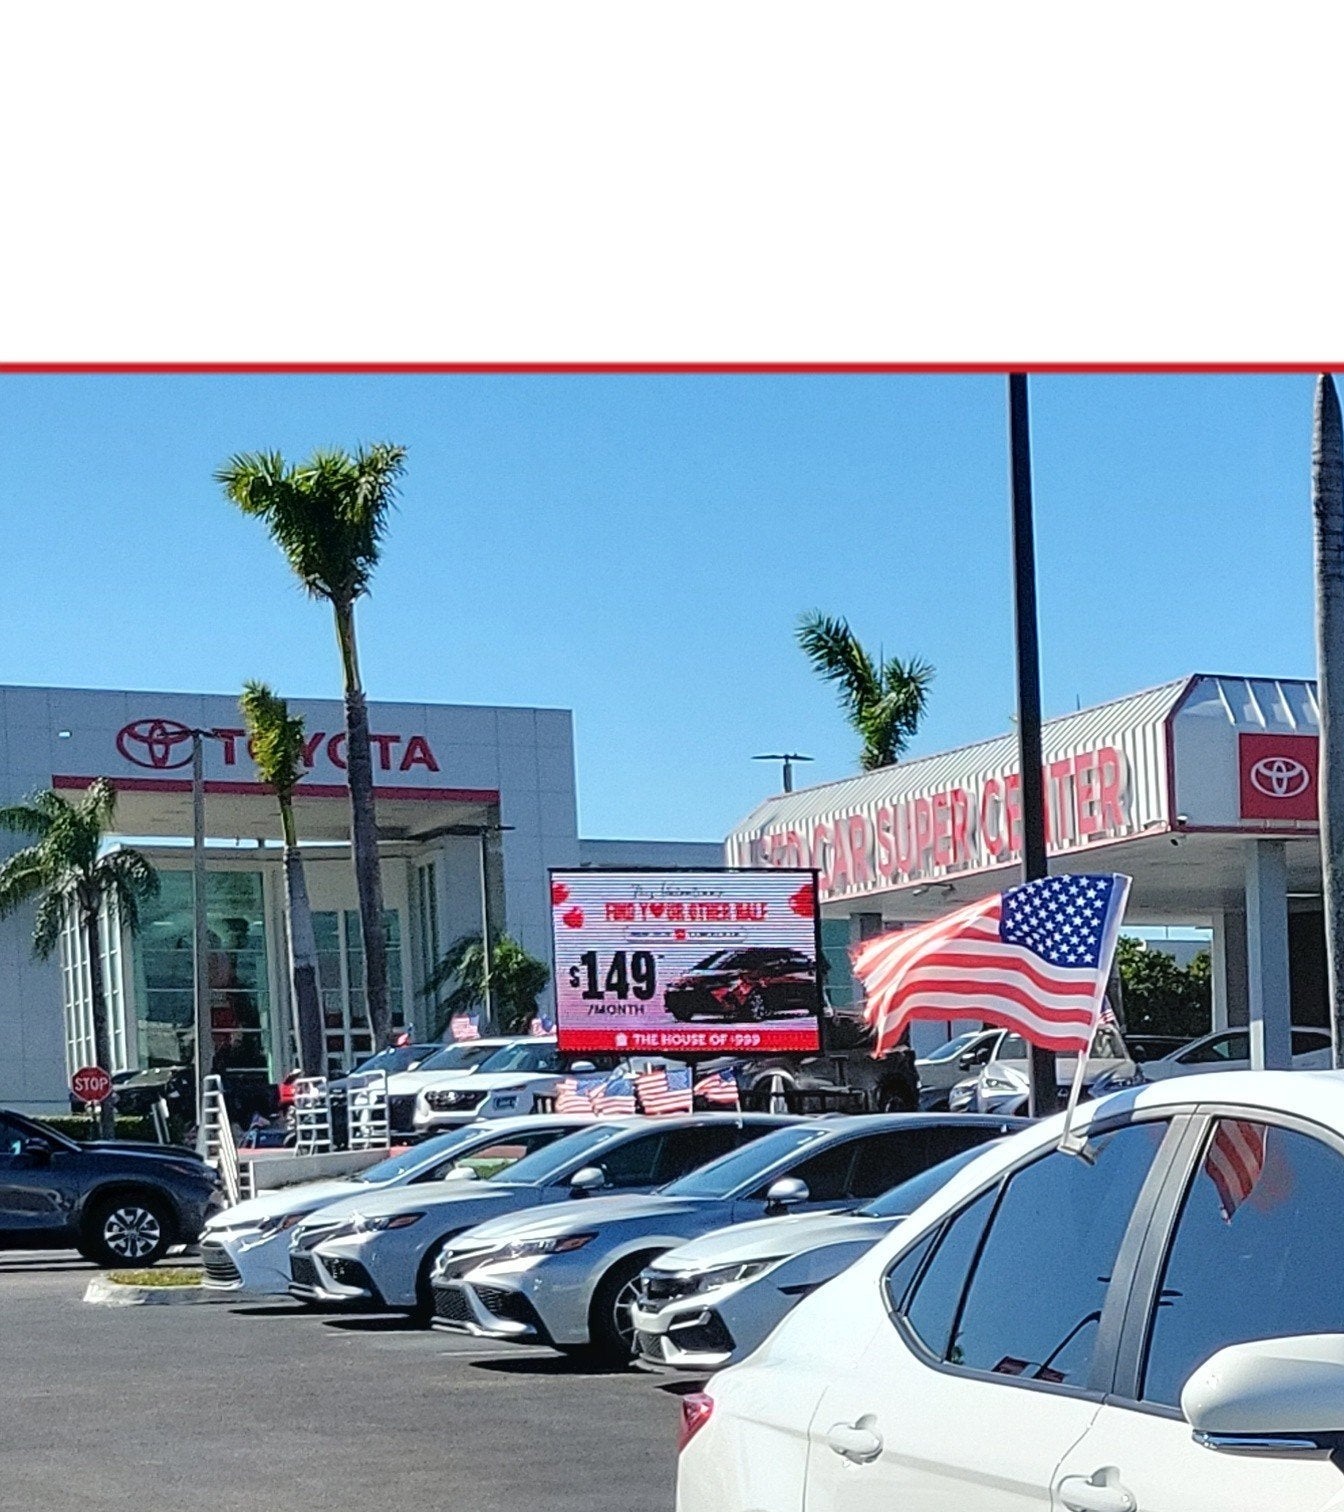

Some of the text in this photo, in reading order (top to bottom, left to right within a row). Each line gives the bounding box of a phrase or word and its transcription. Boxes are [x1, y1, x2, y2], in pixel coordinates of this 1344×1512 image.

[212, 727, 440, 772] TYOTA
[811, 814, 869, 889] CAR
[876, 788, 972, 878] SUPER
[569, 951, 656, 1000] $149
[632, 1033, 658, 1047] THE
[661, 1033, 707, 1047] HOUSE
[709, 1033, 728, 1047] OF
[75, 1077, 109, 1092] STOP
